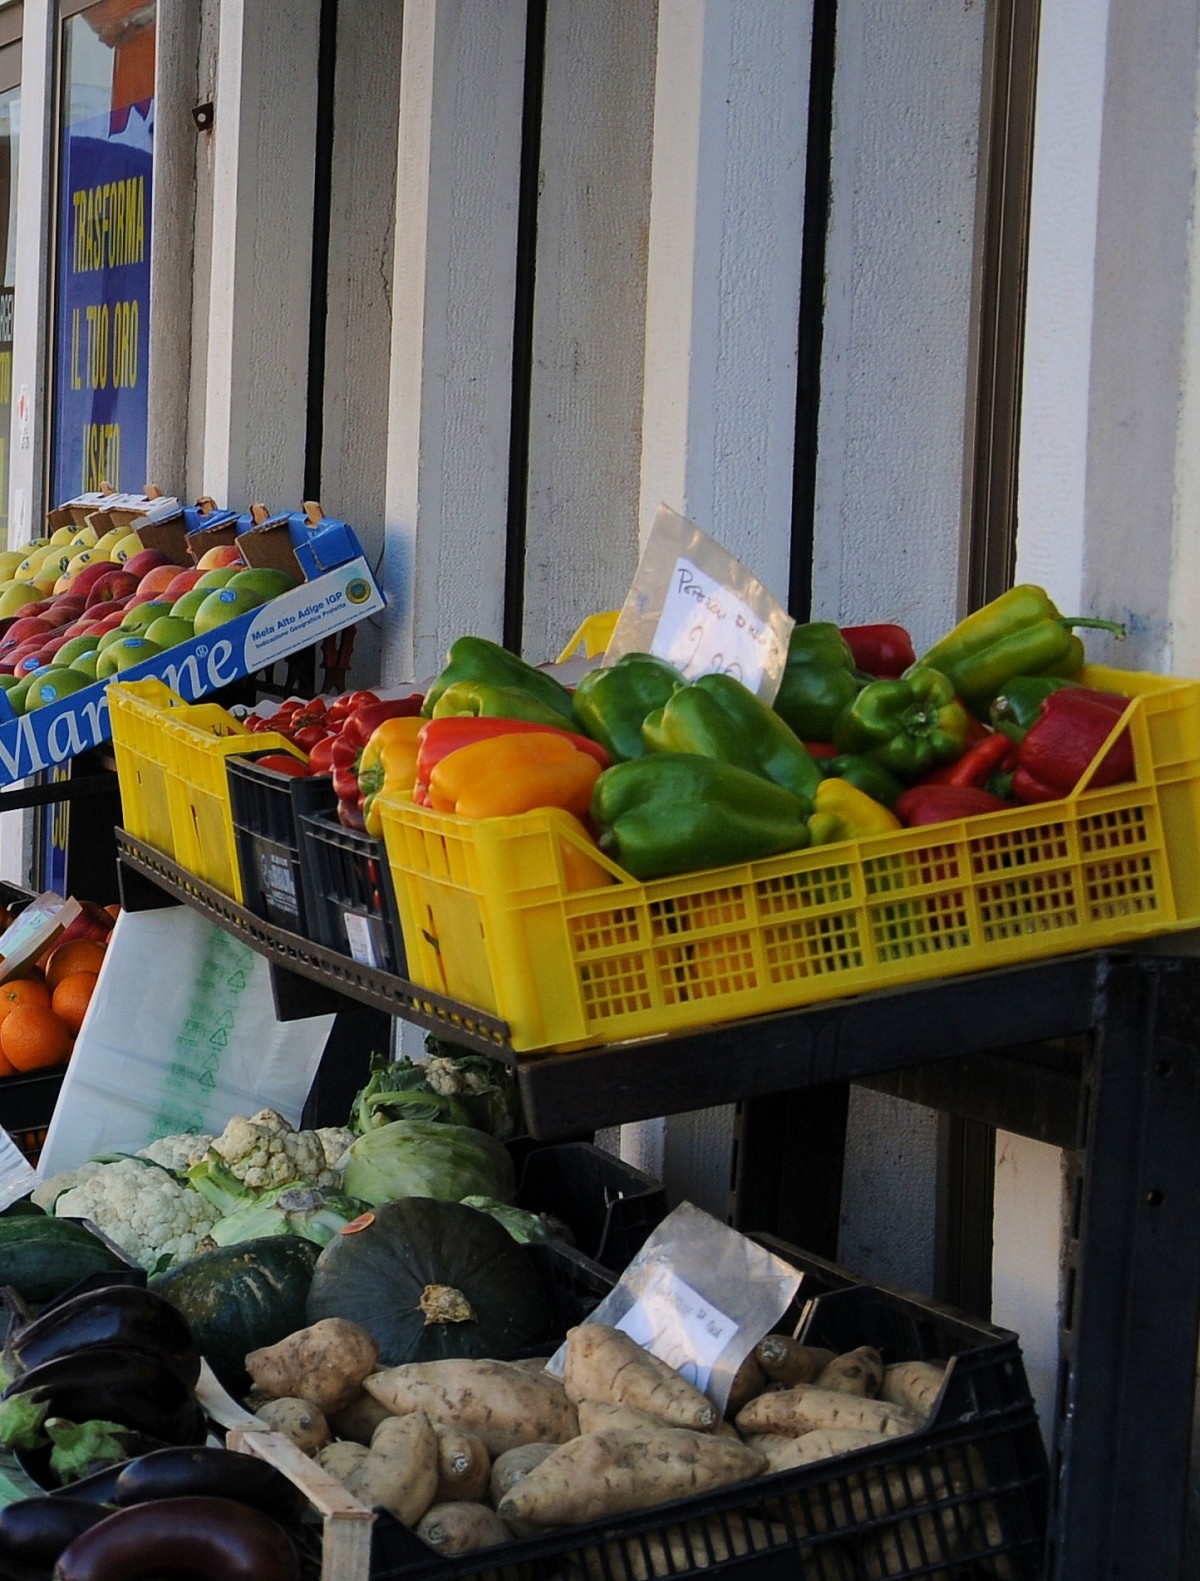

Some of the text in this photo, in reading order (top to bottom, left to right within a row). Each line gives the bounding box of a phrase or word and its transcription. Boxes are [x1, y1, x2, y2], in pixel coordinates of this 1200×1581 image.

[73, 176, 144, 273] TRASFORMA
[71, 299, 139, 390] IL TUO ORO
[81, 422, 120, 493] USATO
[251, 591, 343, 642] Mela Alto Adige IGP
